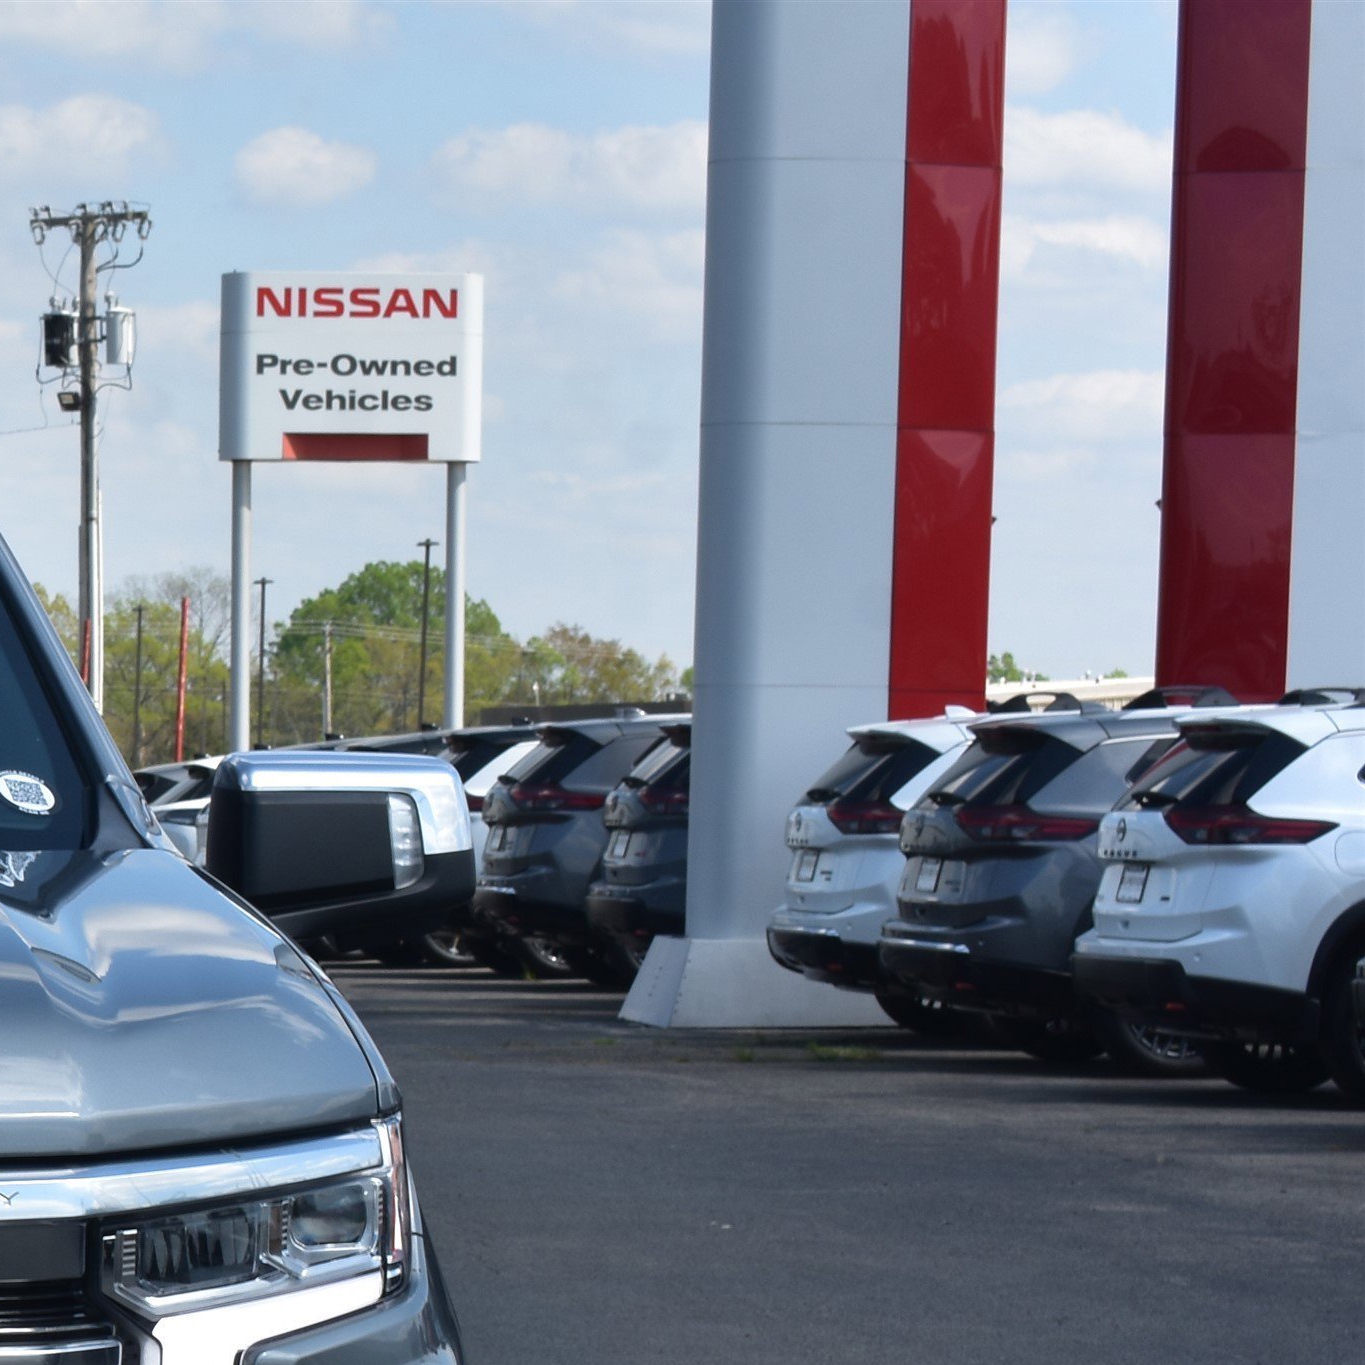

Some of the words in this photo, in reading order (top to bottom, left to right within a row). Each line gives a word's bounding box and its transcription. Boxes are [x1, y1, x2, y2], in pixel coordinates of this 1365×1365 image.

[256, 287, 458, 318] NISSAN
[255, 353, 458, 377] Pre-Owned
[278, 388, 434, 412] Vehicles
